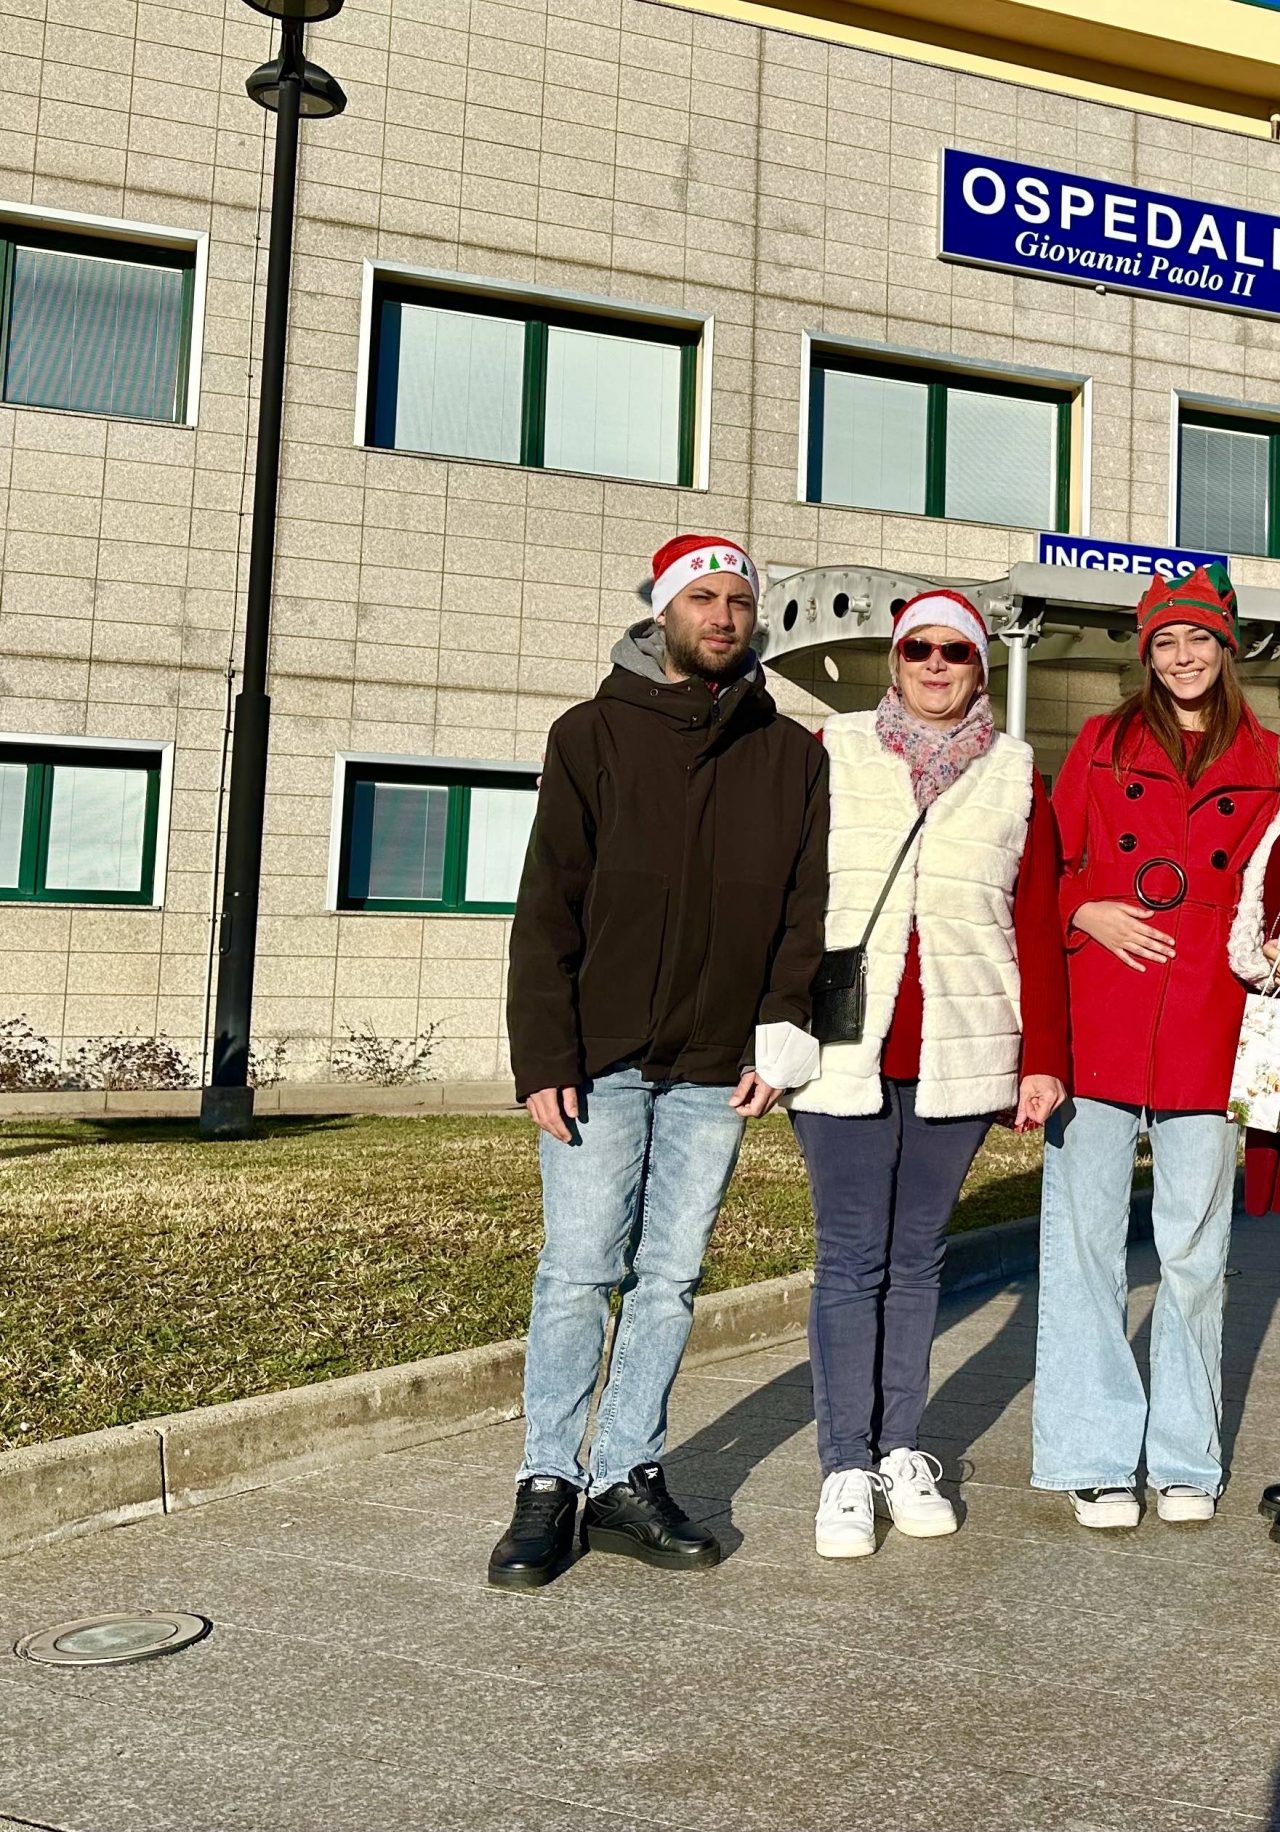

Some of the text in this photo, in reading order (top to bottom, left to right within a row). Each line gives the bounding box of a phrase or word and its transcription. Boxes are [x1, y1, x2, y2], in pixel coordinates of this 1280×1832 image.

[1015, 230, 1256, 297] Giovanni Paolo II
[1046, 544, 1213, 579] INGRESS
